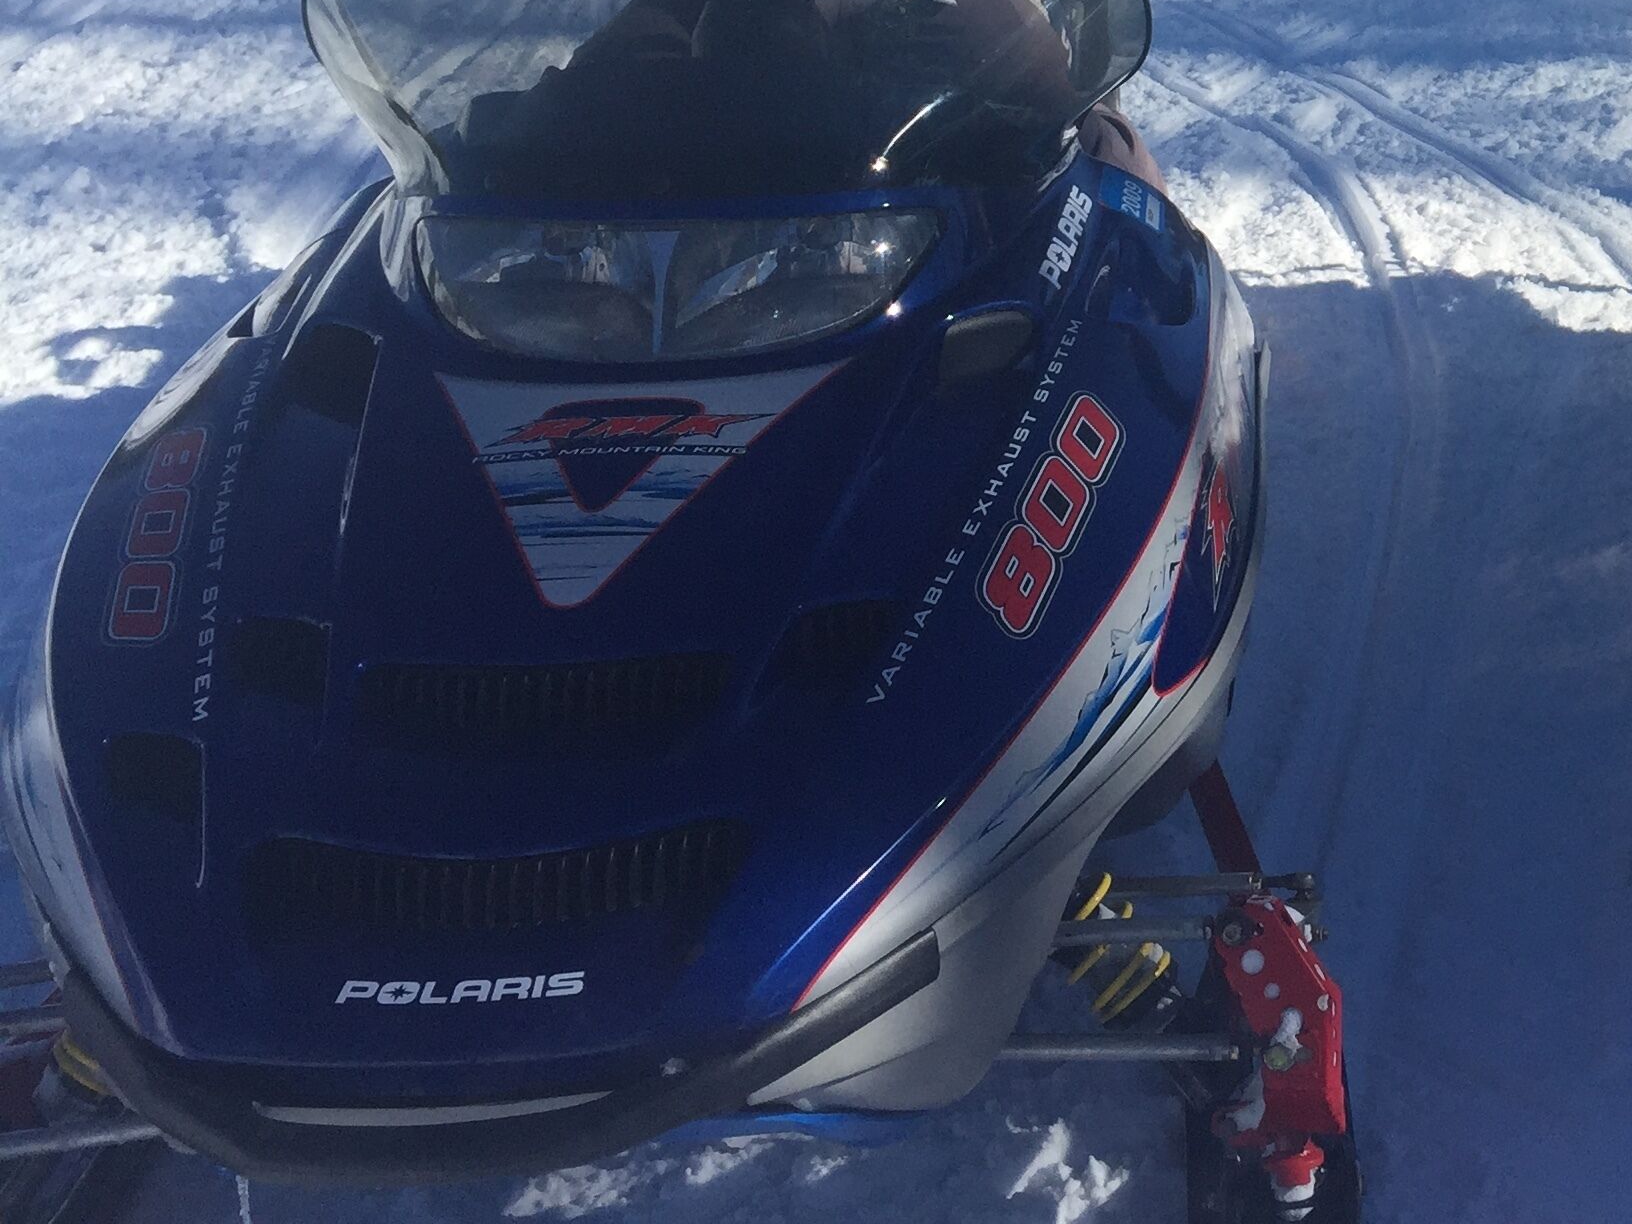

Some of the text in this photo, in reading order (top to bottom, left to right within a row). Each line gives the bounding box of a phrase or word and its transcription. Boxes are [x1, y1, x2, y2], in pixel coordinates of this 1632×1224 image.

[1038, 184, 1093, 290] POLARIS
[1120, 179, 1143, 218] 2009
[472, 445, 747, 464] ROCKY MOUNTAIN KING
[484, 412, 777, 448] RMK
[106, 426, 209, 642] 800
[206, 443, 244, 572] EXHAUST
[865, 318, 1083, 705] VARIABLE EXHAUST SYSTEM
[980, 393, 1122, 635] 800
[191, 586, 219, 722] SYSTEM
[334, 971, 586, 1005] POLARIS
